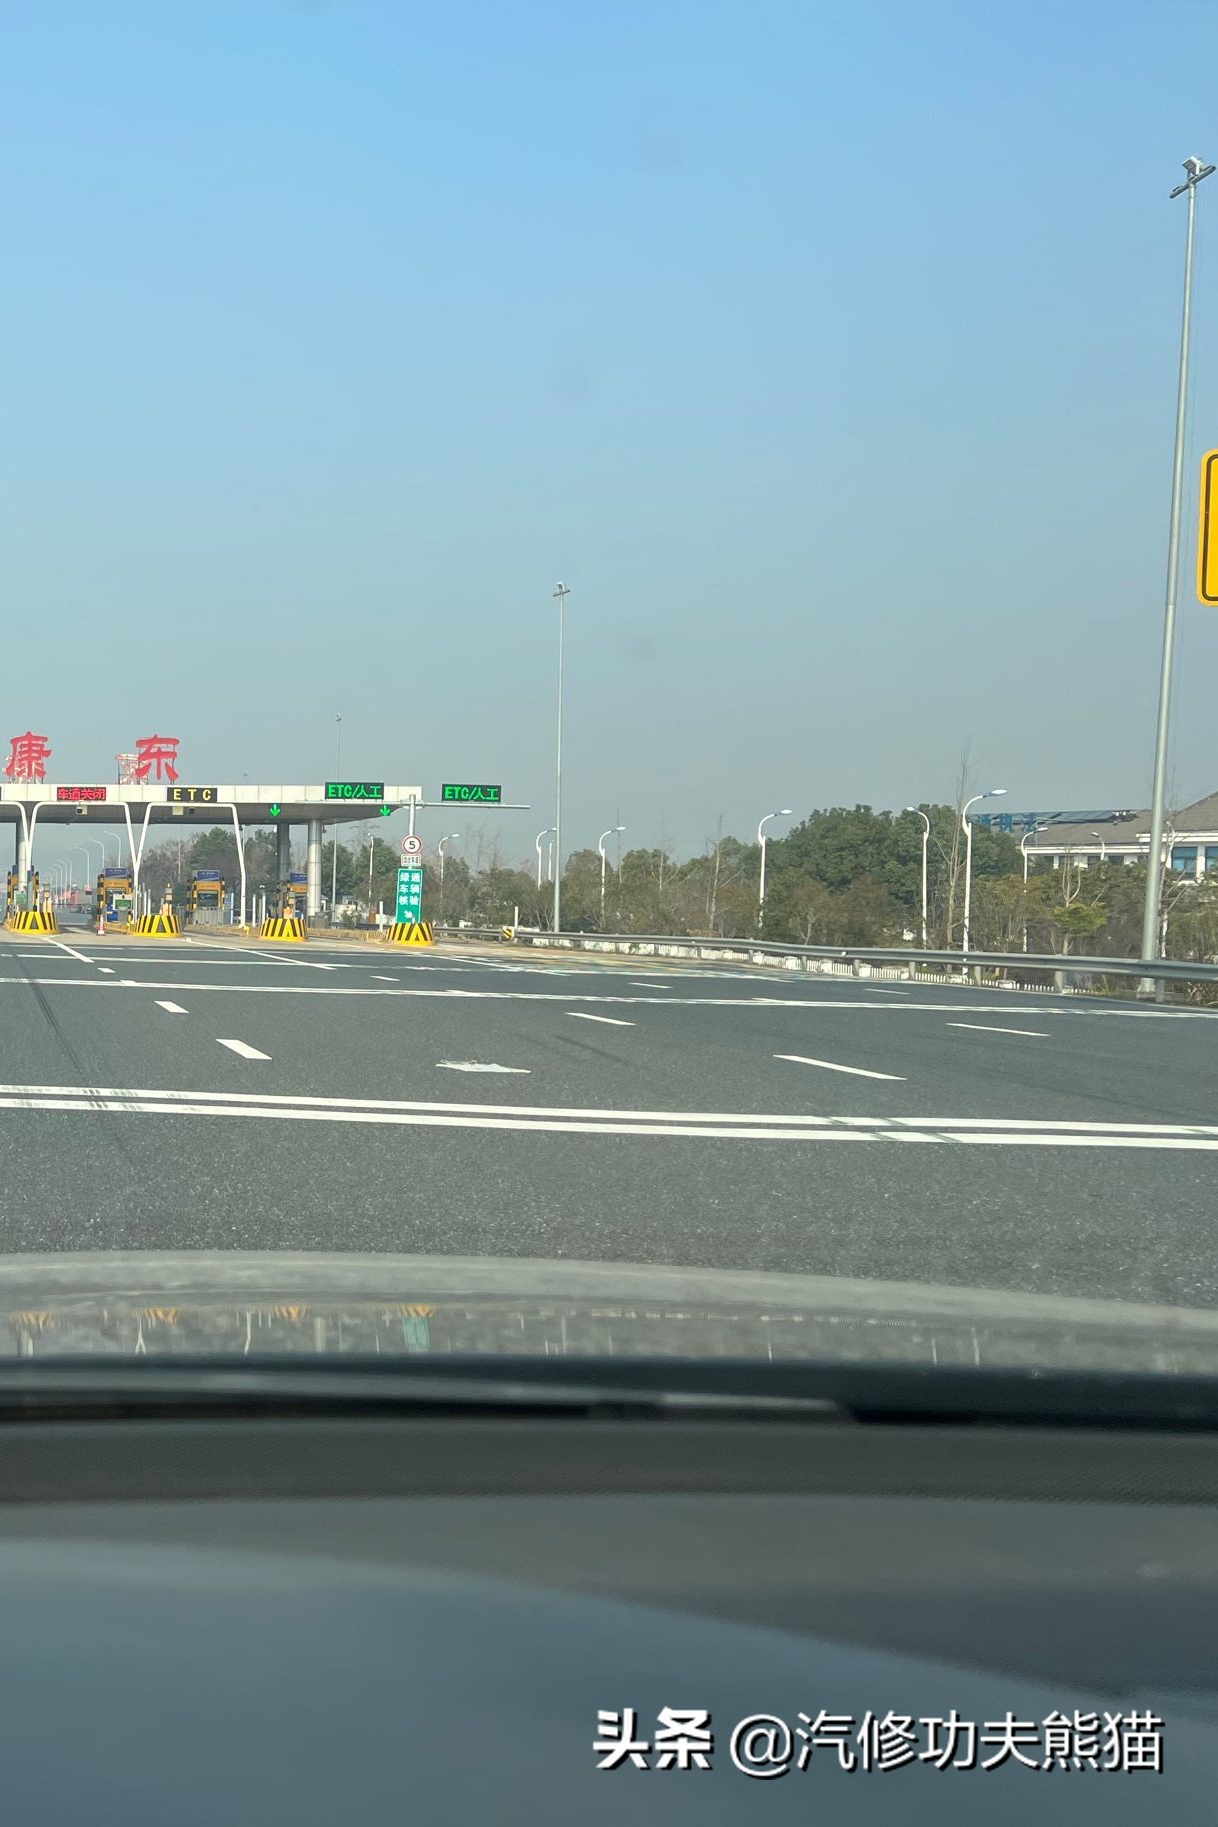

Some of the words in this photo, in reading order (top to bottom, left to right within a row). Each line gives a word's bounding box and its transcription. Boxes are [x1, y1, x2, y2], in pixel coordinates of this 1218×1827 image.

[57, 787, 106, 800] 车道关闭
[173, 788, 212, 800] ETC
[328, 784, 382, 798] ETC/人工
[444, 786, 499, 800] ETC/人工
